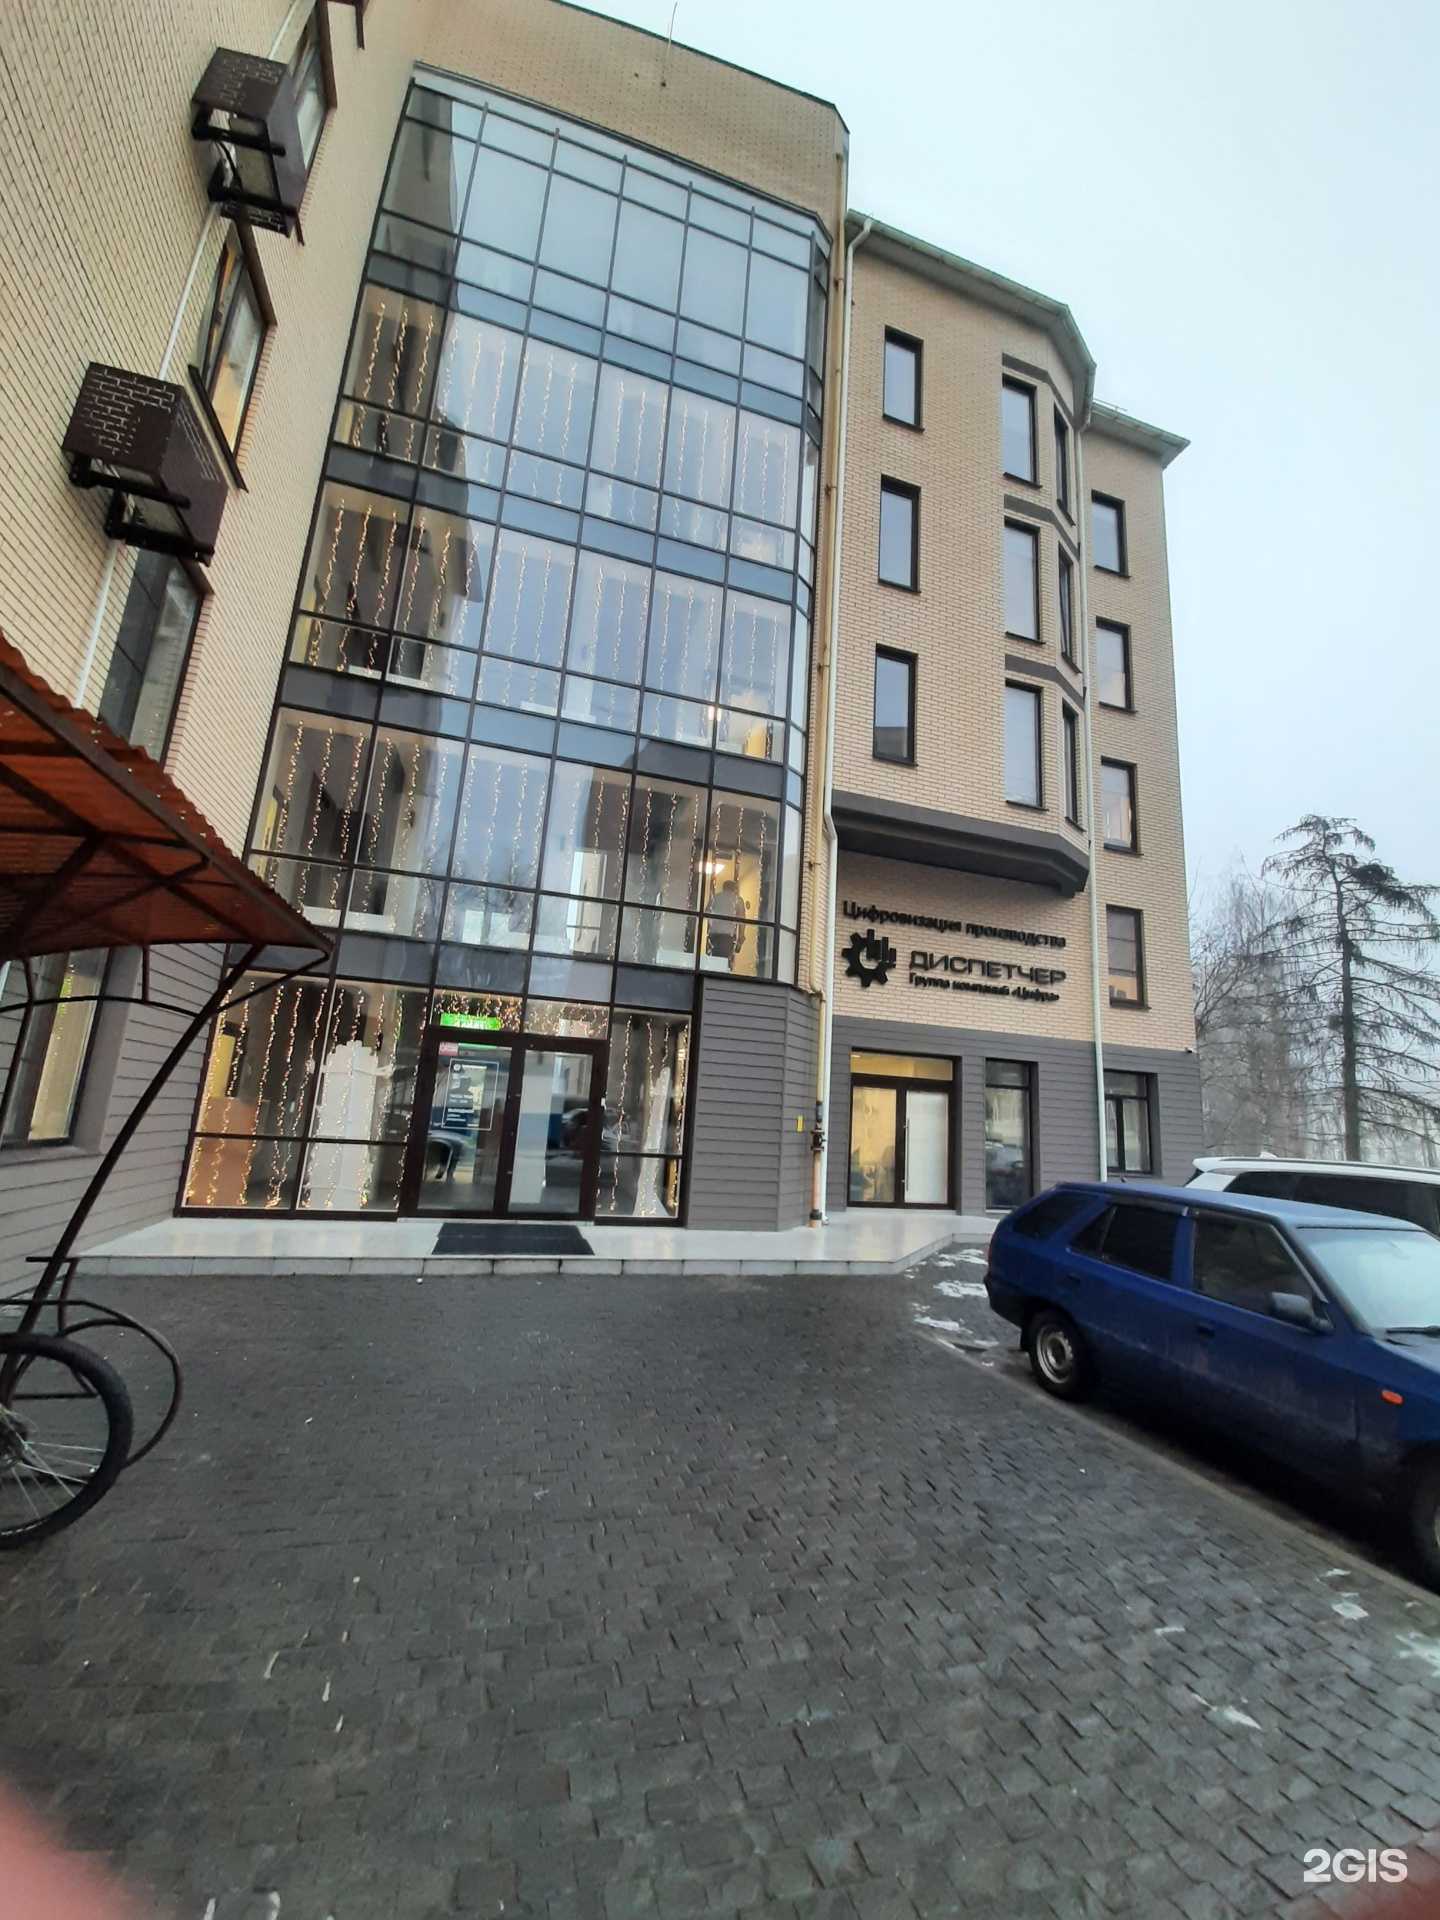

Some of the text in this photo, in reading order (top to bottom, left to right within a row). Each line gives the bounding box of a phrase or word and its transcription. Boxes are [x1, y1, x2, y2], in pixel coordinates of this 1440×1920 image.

[843, 900, 1066, 947] Цифровизация производства
[909, 951, 1067, 984] ДИСПЕТЧЕР
[909, 972, 950, 989] Группа
